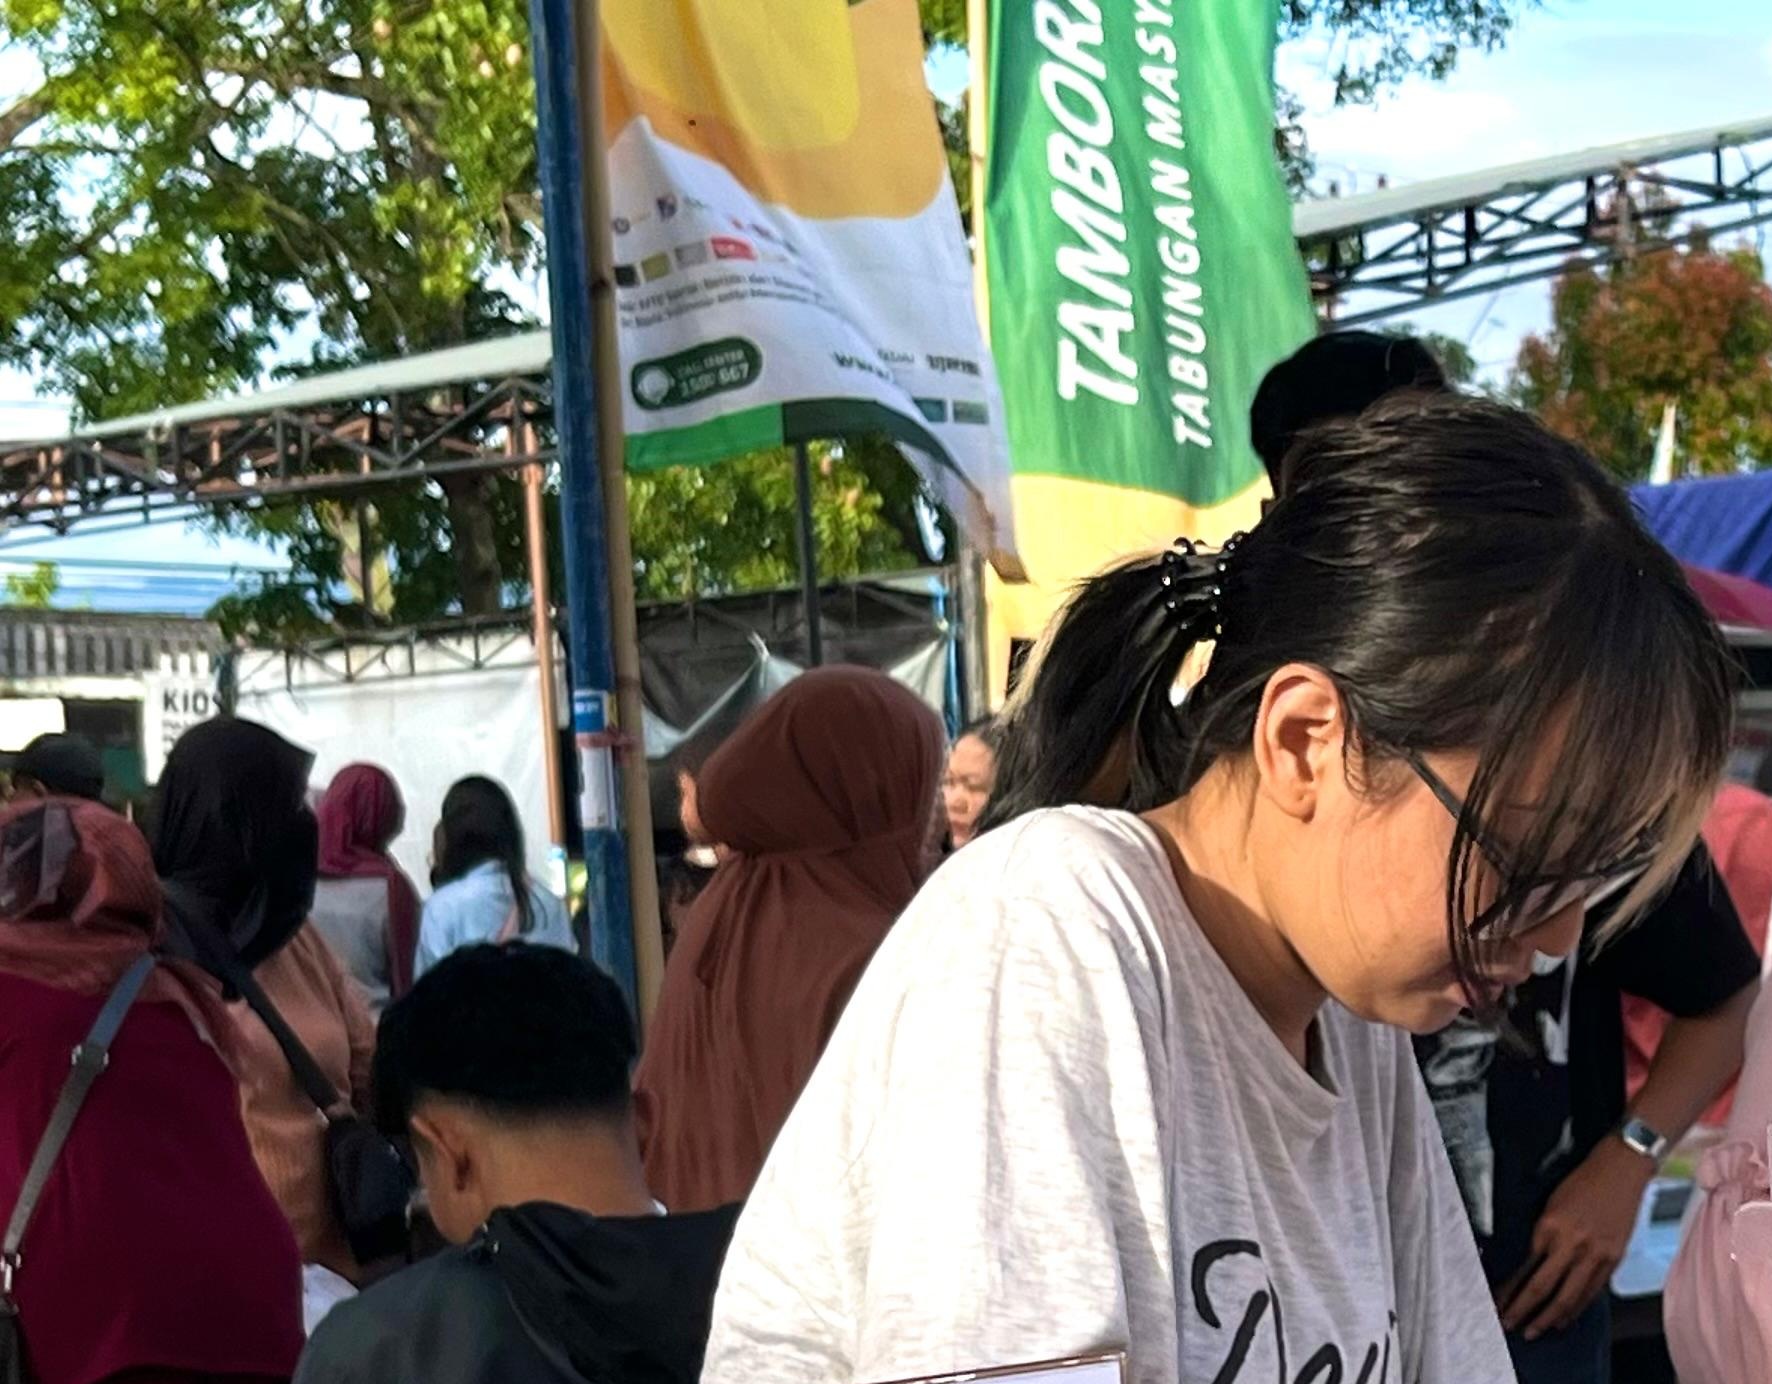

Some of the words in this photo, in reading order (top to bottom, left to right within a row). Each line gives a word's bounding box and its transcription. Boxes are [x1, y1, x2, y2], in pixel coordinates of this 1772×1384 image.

[1033, 0, 1139, 405] TAMBOR
[1134, 0, 1186, 149] MASY
[1149, 158, 1213, 448] TABUNGAN
